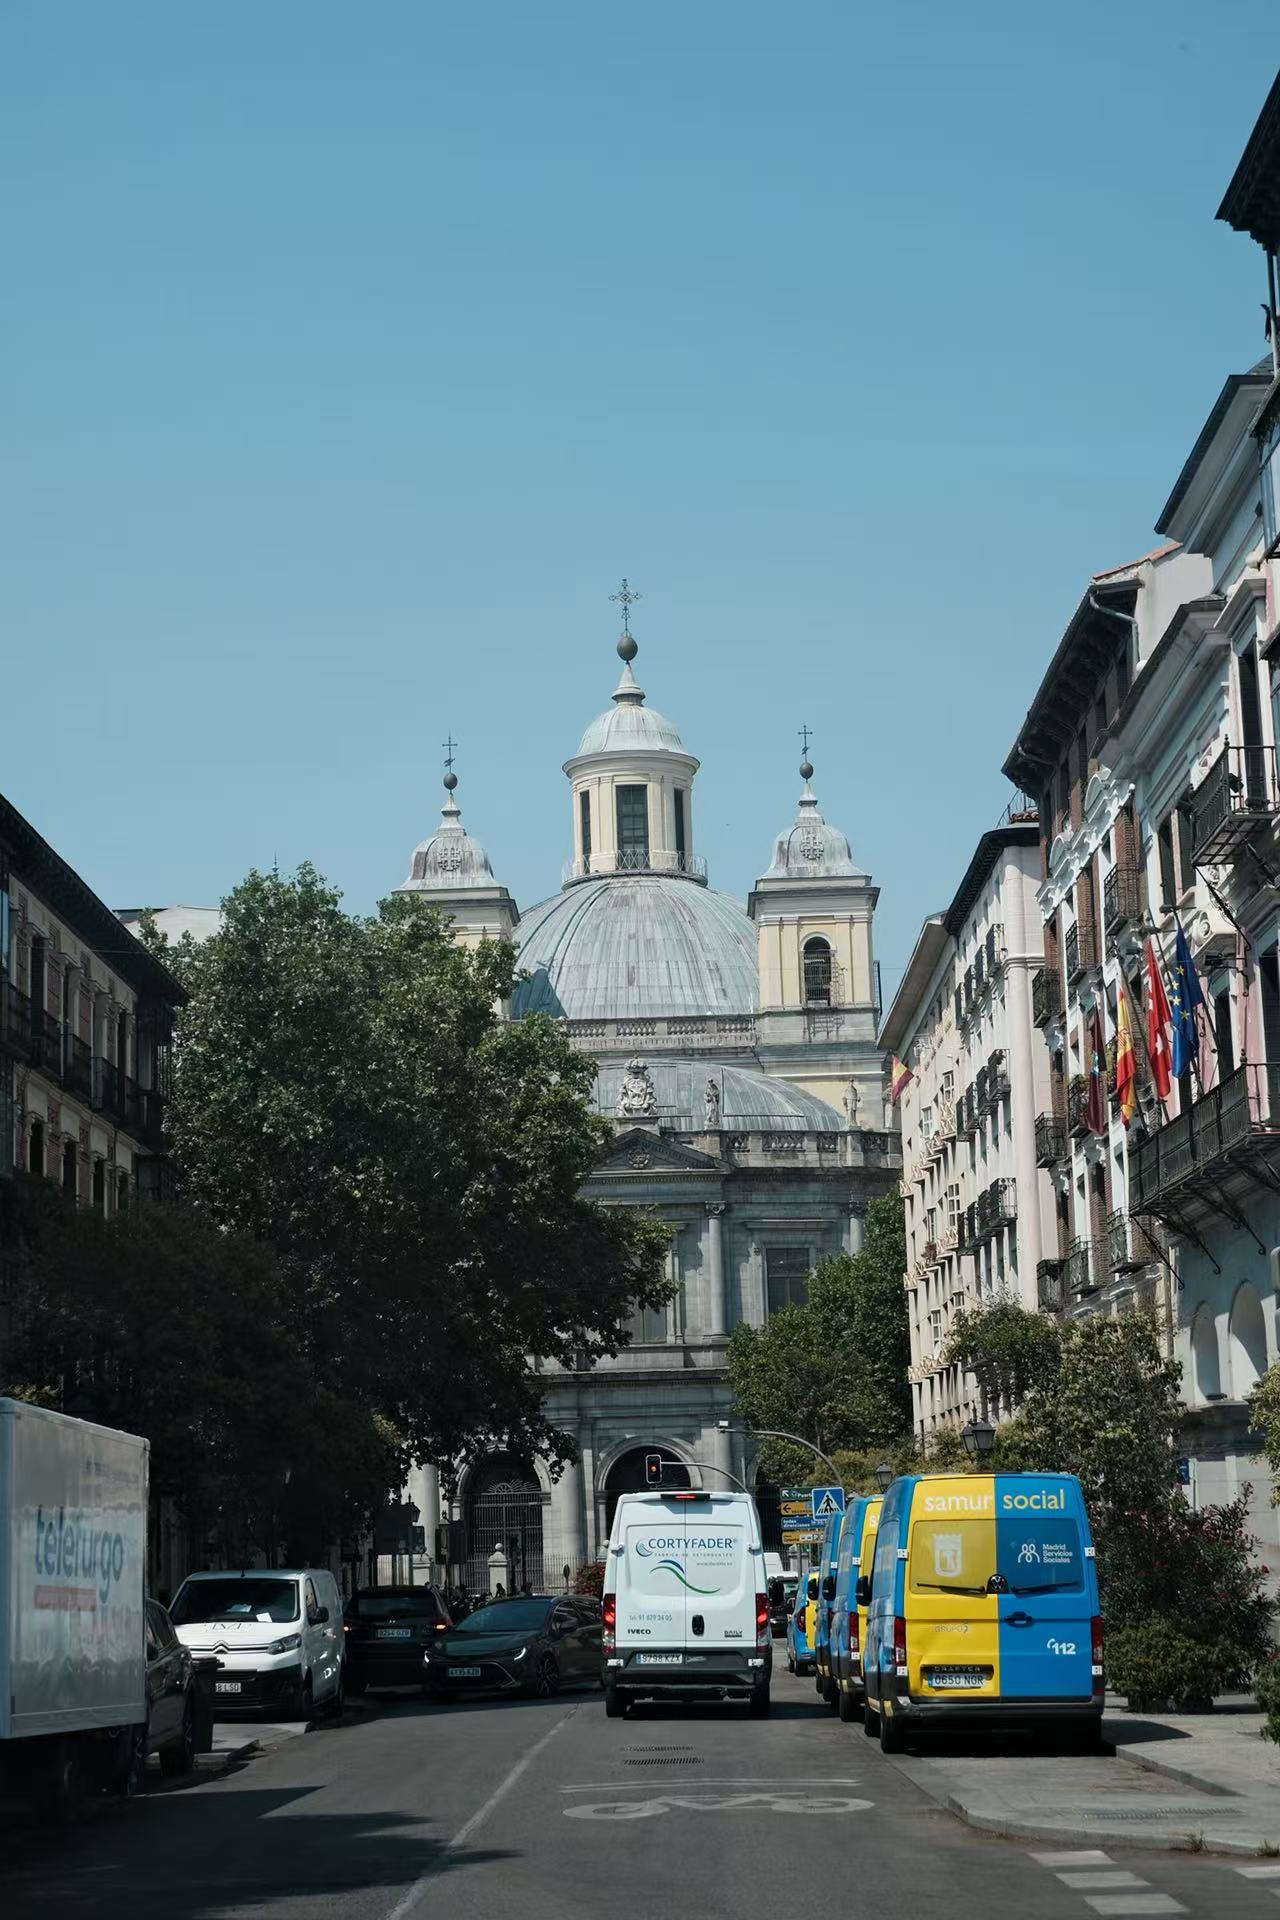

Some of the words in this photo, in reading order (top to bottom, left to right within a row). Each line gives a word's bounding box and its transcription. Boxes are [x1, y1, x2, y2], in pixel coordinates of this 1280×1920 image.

[924, 1496, 993, 1511] samur
[1002, 1489, 1065, 1510] social
[1042, 1543, 1067, 1551] Madrid
[1042, 1550, 1074, 1558] Servicios
[1052, 1643, 1076, 1655] 112
[934, 1674, 962, 1685] 0650
[963, 1674, 985, 1685] NGR
